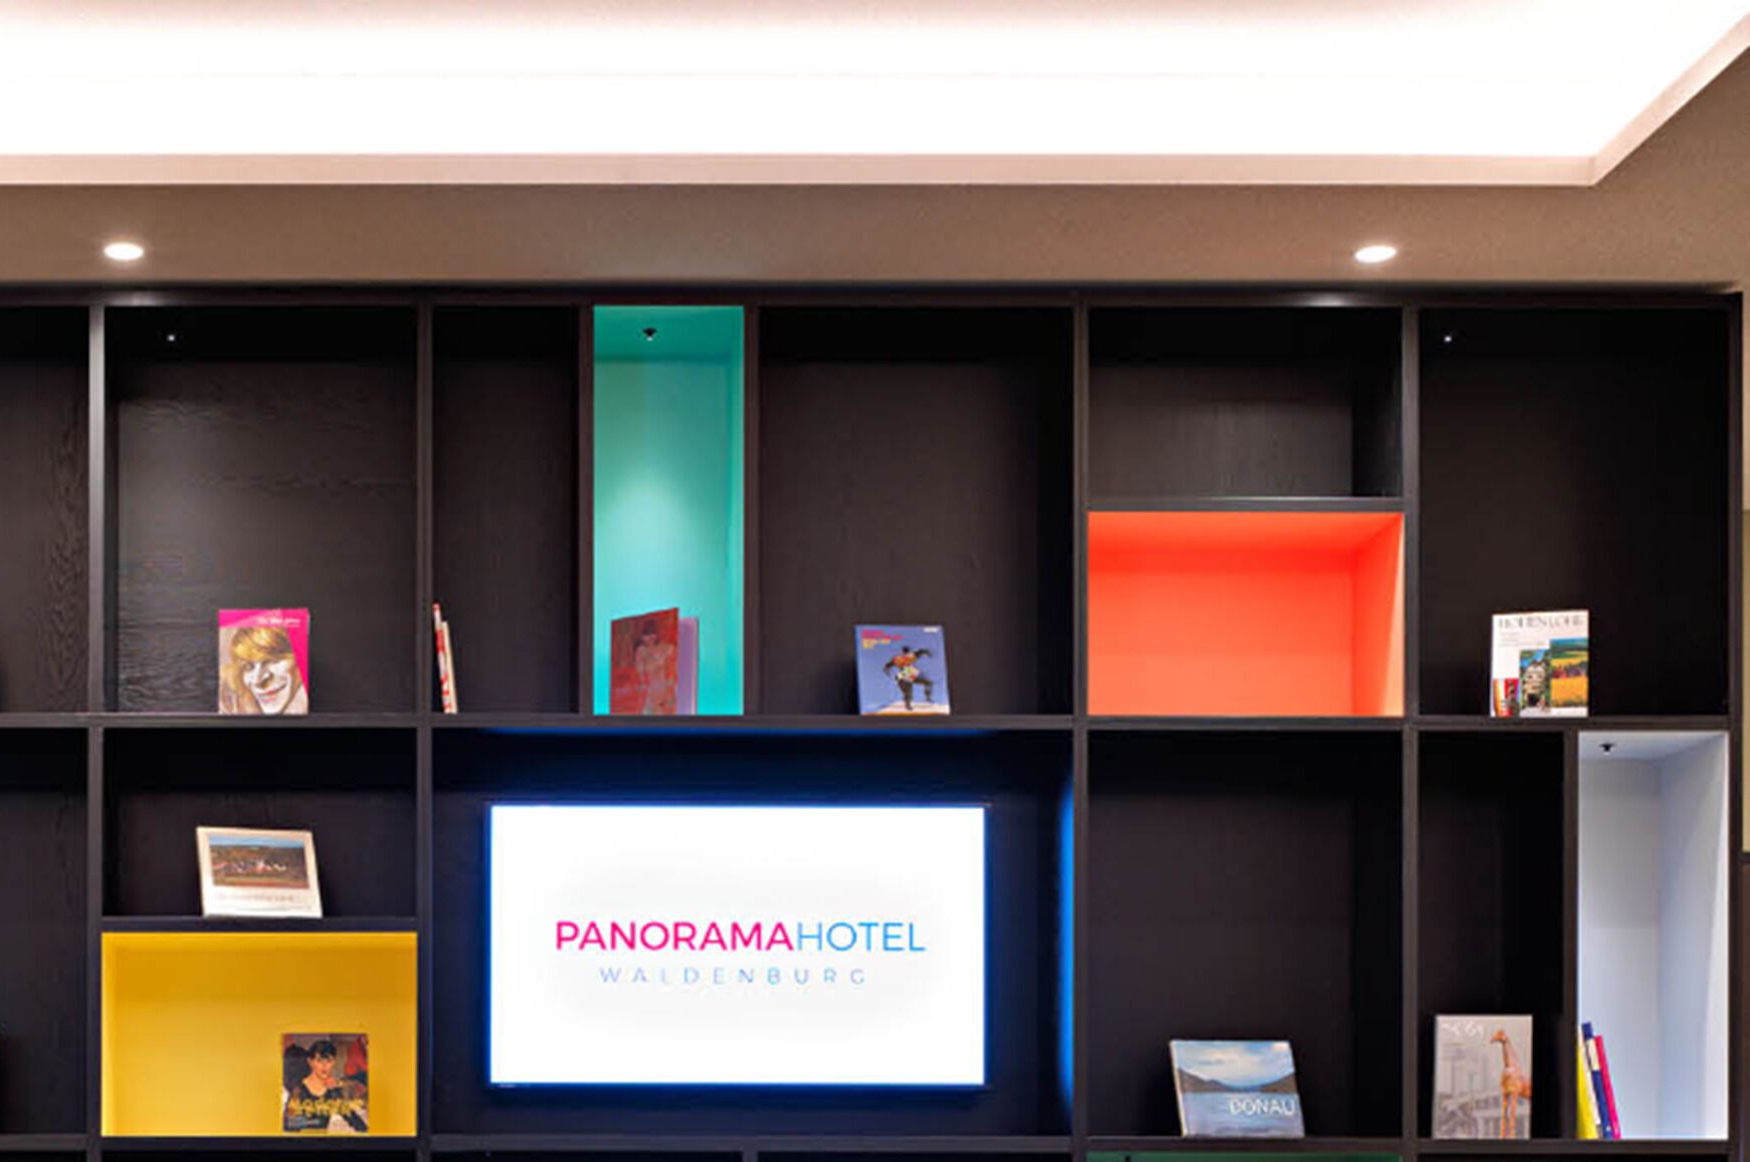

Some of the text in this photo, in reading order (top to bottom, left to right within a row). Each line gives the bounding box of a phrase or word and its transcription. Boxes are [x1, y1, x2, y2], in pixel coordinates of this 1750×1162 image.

[555, 920, 927, 952] PANORAMAHOTEL
[599, 966, 866, 985] WALDENBURG
[1229, 1097, 1295, 1116] DONAU
